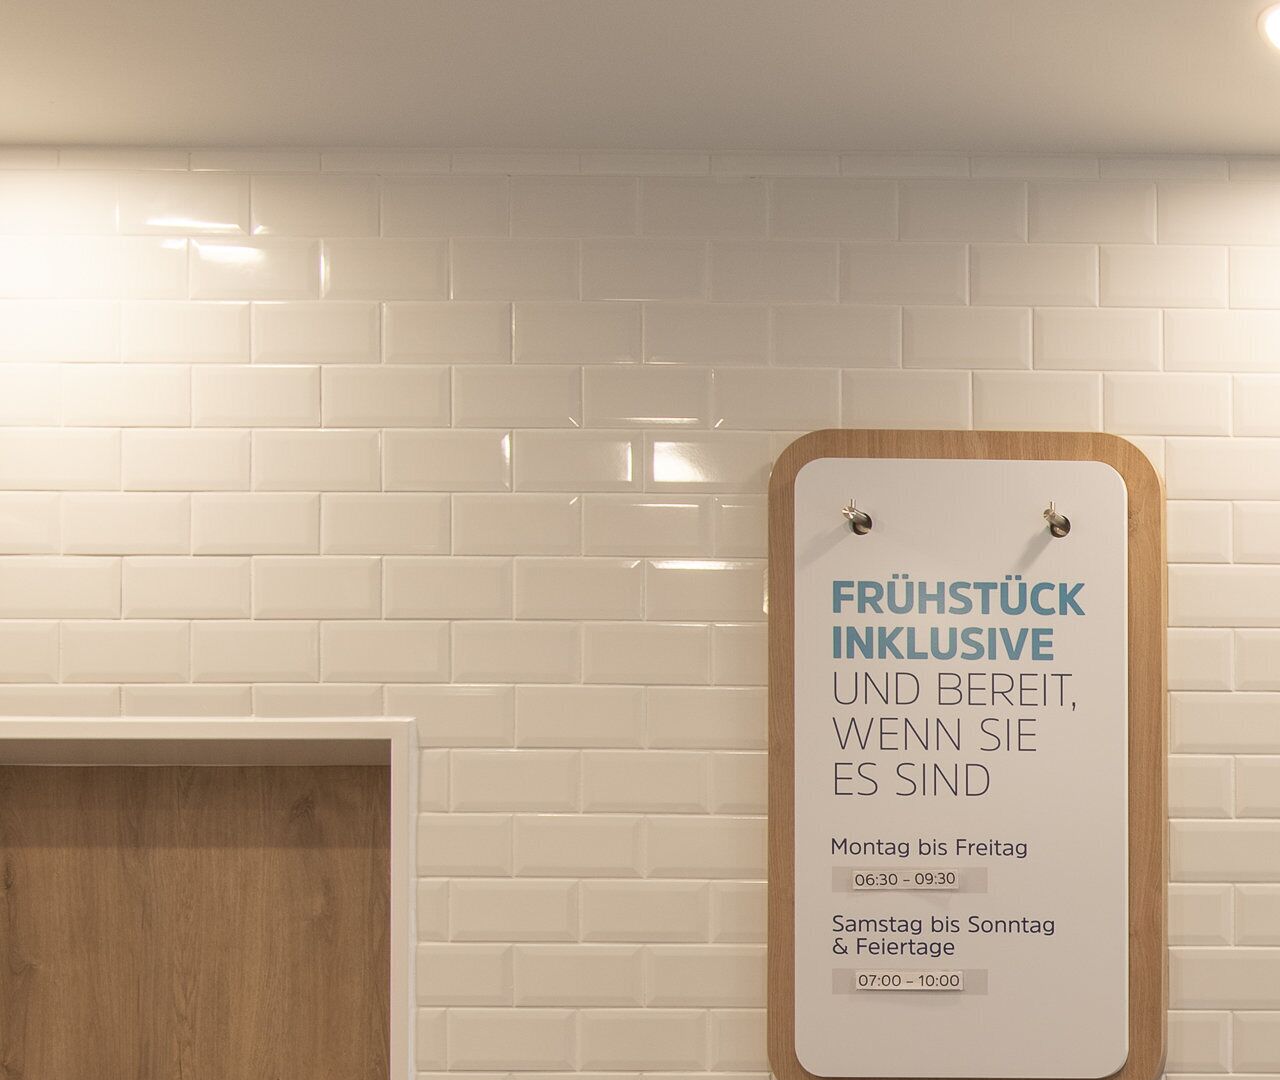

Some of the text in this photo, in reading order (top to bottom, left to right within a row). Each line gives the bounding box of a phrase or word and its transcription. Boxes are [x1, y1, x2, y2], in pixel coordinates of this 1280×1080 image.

[833, 574, 1085, 615] FRÜHSTÜCK
[833, 626, 1053, 660] INKLUSIVE
[834, 672, 1075, 711] UND BEREIT,
[833, 717, 1036, 751] WENN SIE
[835, 763, 989, 796] ES SIND
[832, 838, 1027, 858] Montag bis Freitag
[855, 872, 897, 887] 06:30
[914, 871, 956, 886] 09:30
[833, 915, 1054, 936] Samstag bis Sonntag
[833, 937, 955, 959] & Feiertage
[858, 974, 901, 988] 07:00
[919, 974, 960, 987] 10:00
